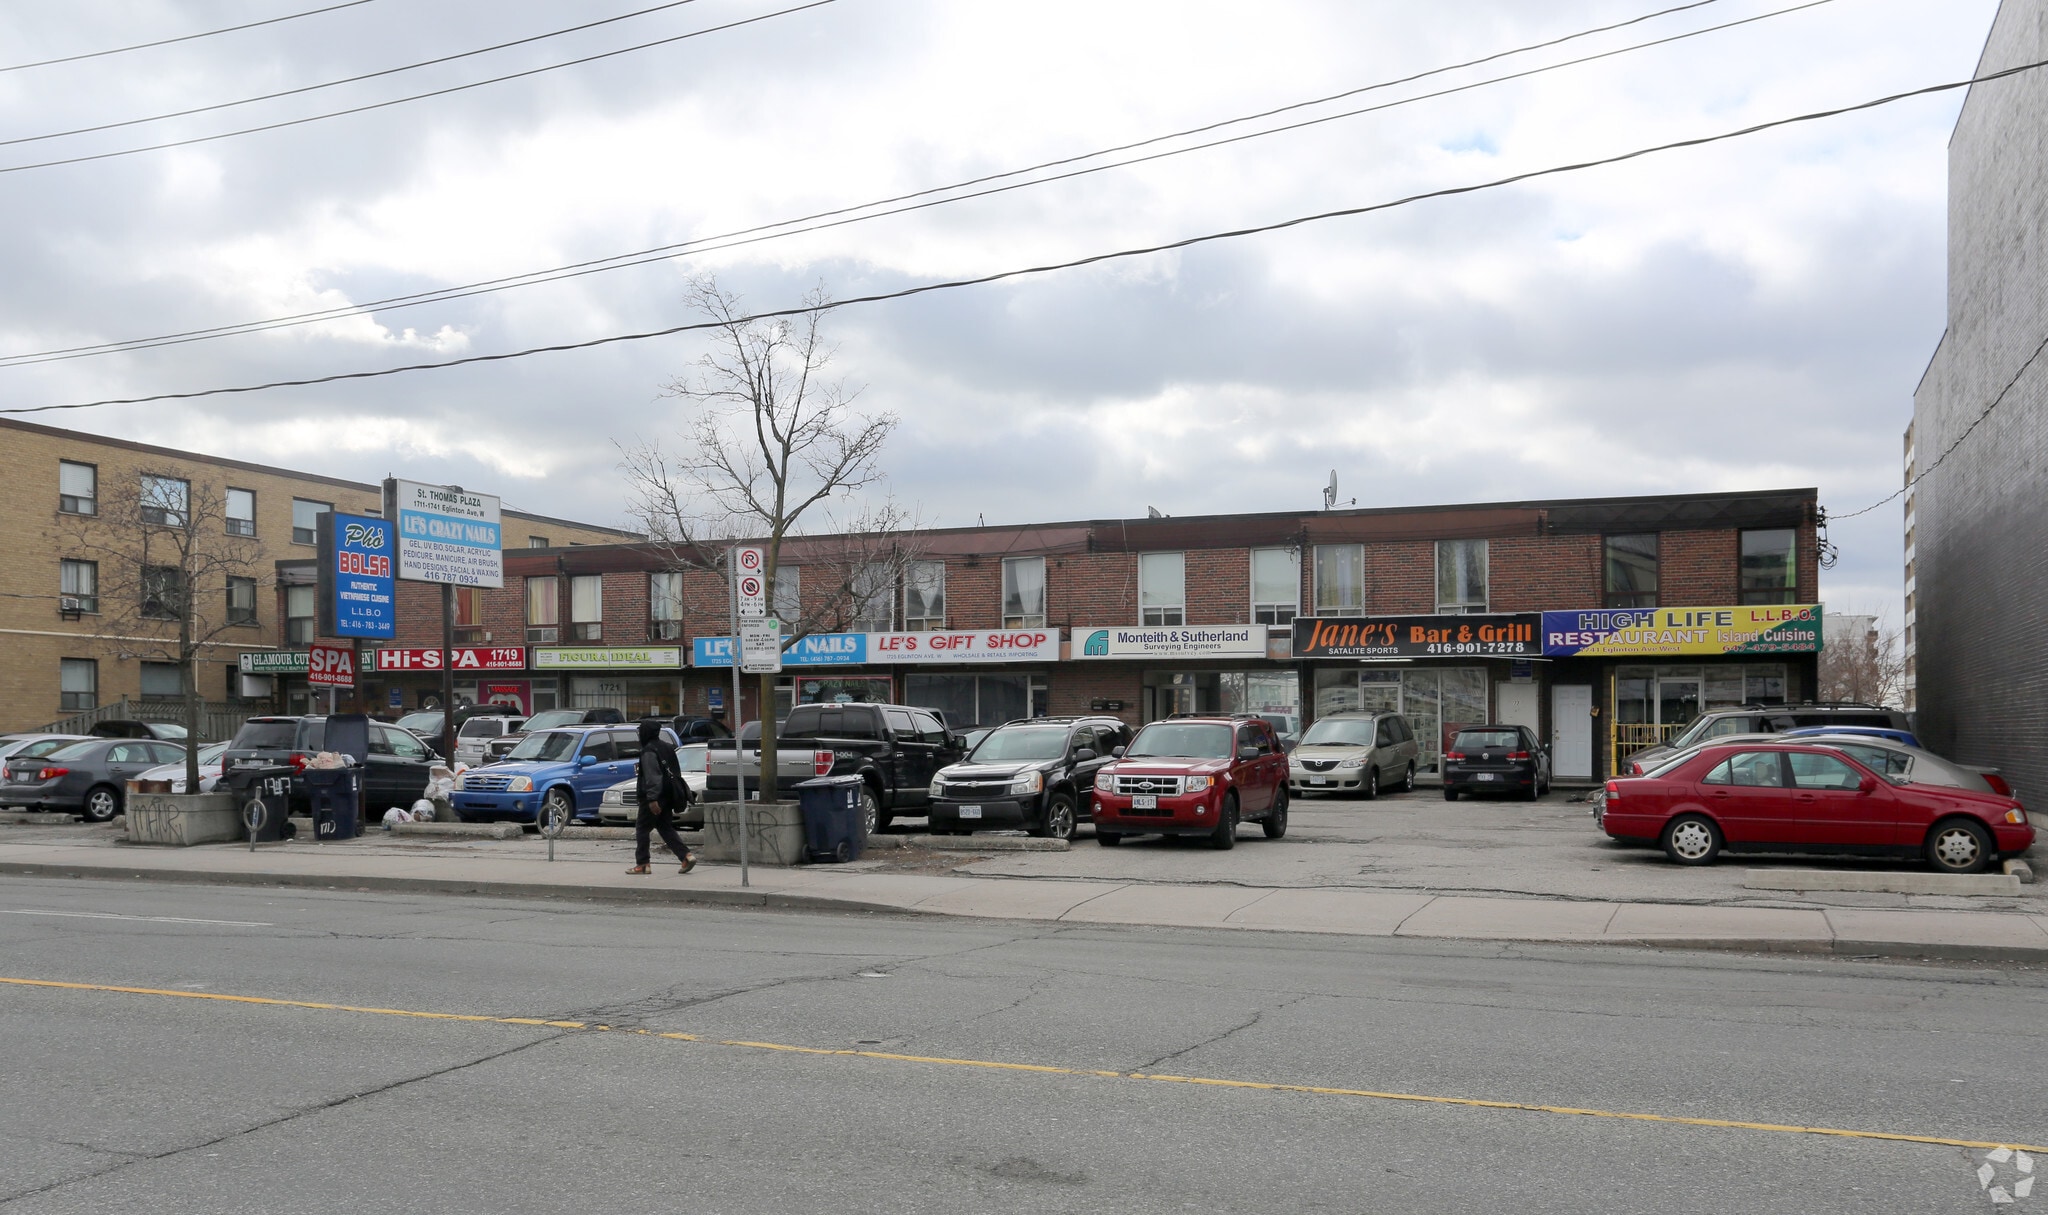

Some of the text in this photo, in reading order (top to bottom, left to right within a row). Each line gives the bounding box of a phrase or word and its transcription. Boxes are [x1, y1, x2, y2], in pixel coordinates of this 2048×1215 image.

[417, 488, 481, 507] St. THOMAS PLAZA
[414, 500, 440, 510] 1711-1741
[442, 504, 464, 514] Eglinton
[404, 515, 496, 544] LE'S CRAZY NAILS
[468, 548, 492, 557] ACRYLIC
[339, 550, 390, 578] BOLSA
[404, 560, 422, 570] HAND
[450, 566, 472, 575] FACIAL
[472, 568, 476, 576] &
[476, 568, 499, 578] WAXING
[424, 571, 479, 584] 416 787 0934
[350, 581, 378, 592] AUTHENTIC
[340, 591, 390, 604] VIETNAMESE CUISINE
[1578, 610, 1734, 630] HIGH LIFE
[1750, 608, 1816, 622] L.L.B.O.
[1118, 630, 1248, 644] Monteith & Sutherland
[1302, 620, 1398, 652] Jane's
[1410, 623, 1532, 644] Bar & Grill
[1549, 628, 1816, 646] RESTAURANT Island Cuisine
[806, 636, 857, 654] NAILS
[878, 632, 1047, 651] LE'S GIFT SHOP
[1144, 643, 1182, 651] Surveying
[1426, 642, 1524, 654] 416-901-7278
[490, 649, 518, 660] 1719
[559, 652, 608, 662] FIGURA
[610, 652, 651, 662] IDEAL
[1328, 647, 1366, 655] SATALITE
[253, 654, 292, 666] GLAMOUR
[310, 648, 352, 674] SPA
[381, 650, 480, 668] Hi-SPA
[310, 672, 352, 683] 416-901-8688
